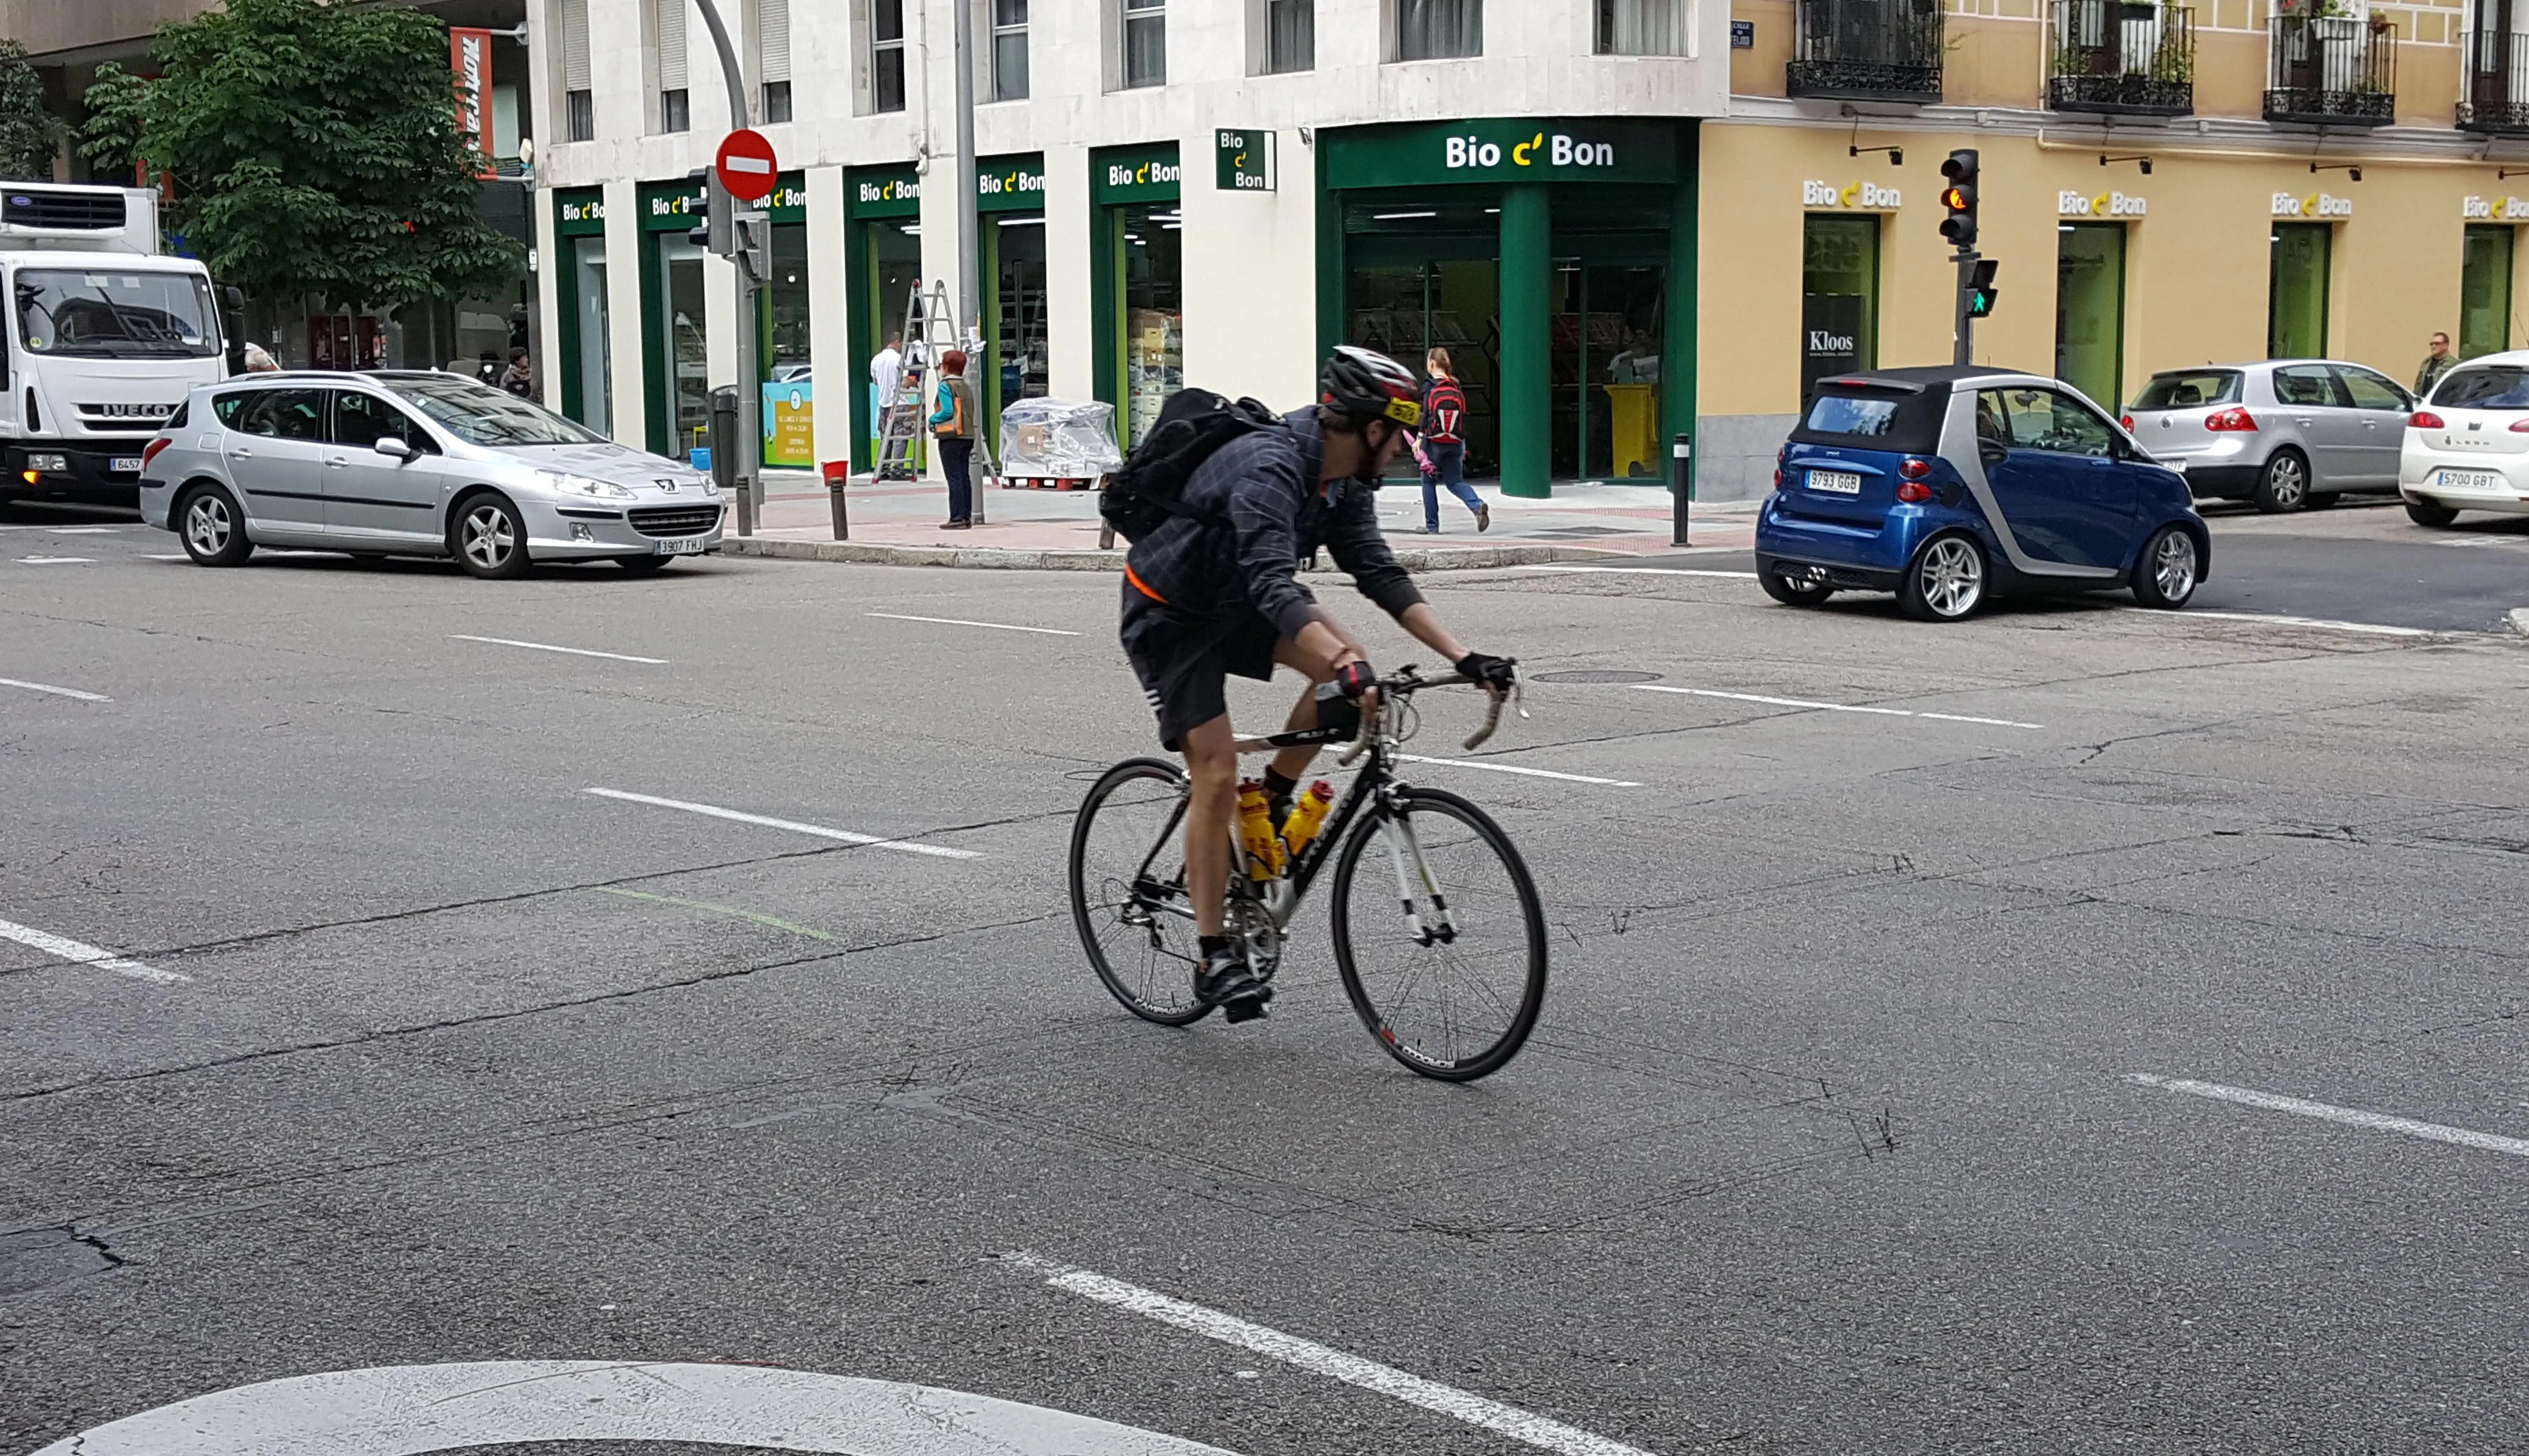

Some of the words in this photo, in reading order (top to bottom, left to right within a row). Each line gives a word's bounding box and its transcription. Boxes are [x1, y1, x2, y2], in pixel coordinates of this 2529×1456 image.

[1220, 132, 1243, 148] Bio
[1446, 135, 1501, 168] Bio
[1552, 135, 1613, 165] Bon
[979, 174, 1001, 194] Bio
[1019, 172, 1045, 191] Bon
[1109, 165, 1132, 186] Bio
[1152, 162, 1180, 182] Bon
[1235, 172, 1263, 188] Bon
[860, 183, 880, 202] Bio
[895, 181, 920, 199] Bon
[1803, 180, 1837, 205] Bio
[1862, 182, 1901, 206] Bon
[563, 203, 580, 221] Bio
[592, 202, 605, 218] Bo
[652, 197, 669, 215] Bio
[2058, 190, 2089, 214] Bio
[2111, 191, 2146, 214] Bon
[2271, 192, 2299, 214] Bio
[2319, 193, 2352, 215] Bon
[2463, 195, 2489, 217] Bio
[1810, 331, 1853, 351] Kloos
[103, 404, 169, 417] IVECO
[118, 460, 140, 469] 6457
[1812, 472, 1834, 488] 9793
[1838, 475, 1857, 489] GGB
[2444, 473, 2470, 485] 5700
[2473, 475, 2495, 487] GBT
[662, 540, 683, 552] 3907
[686, 539, 702, 551] FHJ
